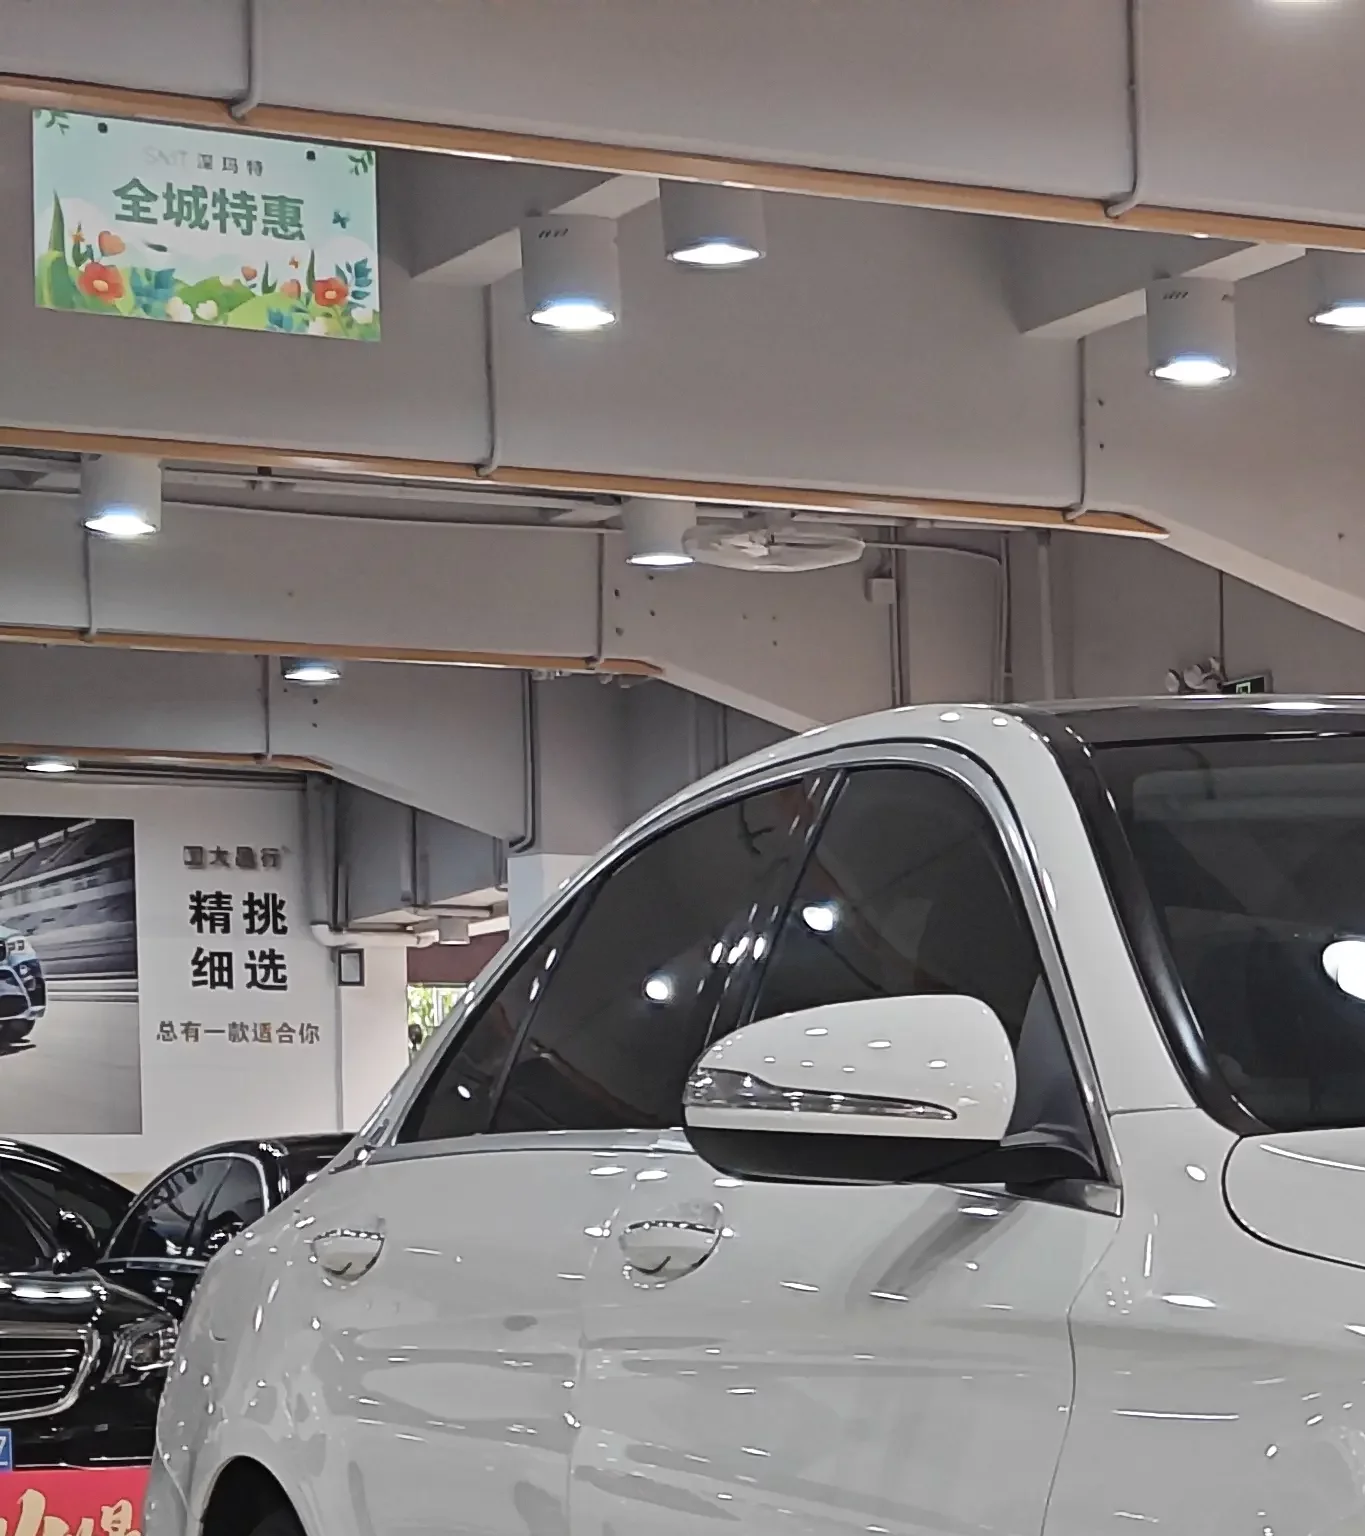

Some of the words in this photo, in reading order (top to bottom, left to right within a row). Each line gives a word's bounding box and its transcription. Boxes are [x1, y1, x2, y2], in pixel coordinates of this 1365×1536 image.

[113, 177, 305, 241] 全城特惠
[188, 890, 289, 936] 精挑
[190, 947, 289, 992] 细选
[156, 1020, 320, 1045] 总有一款适合你
